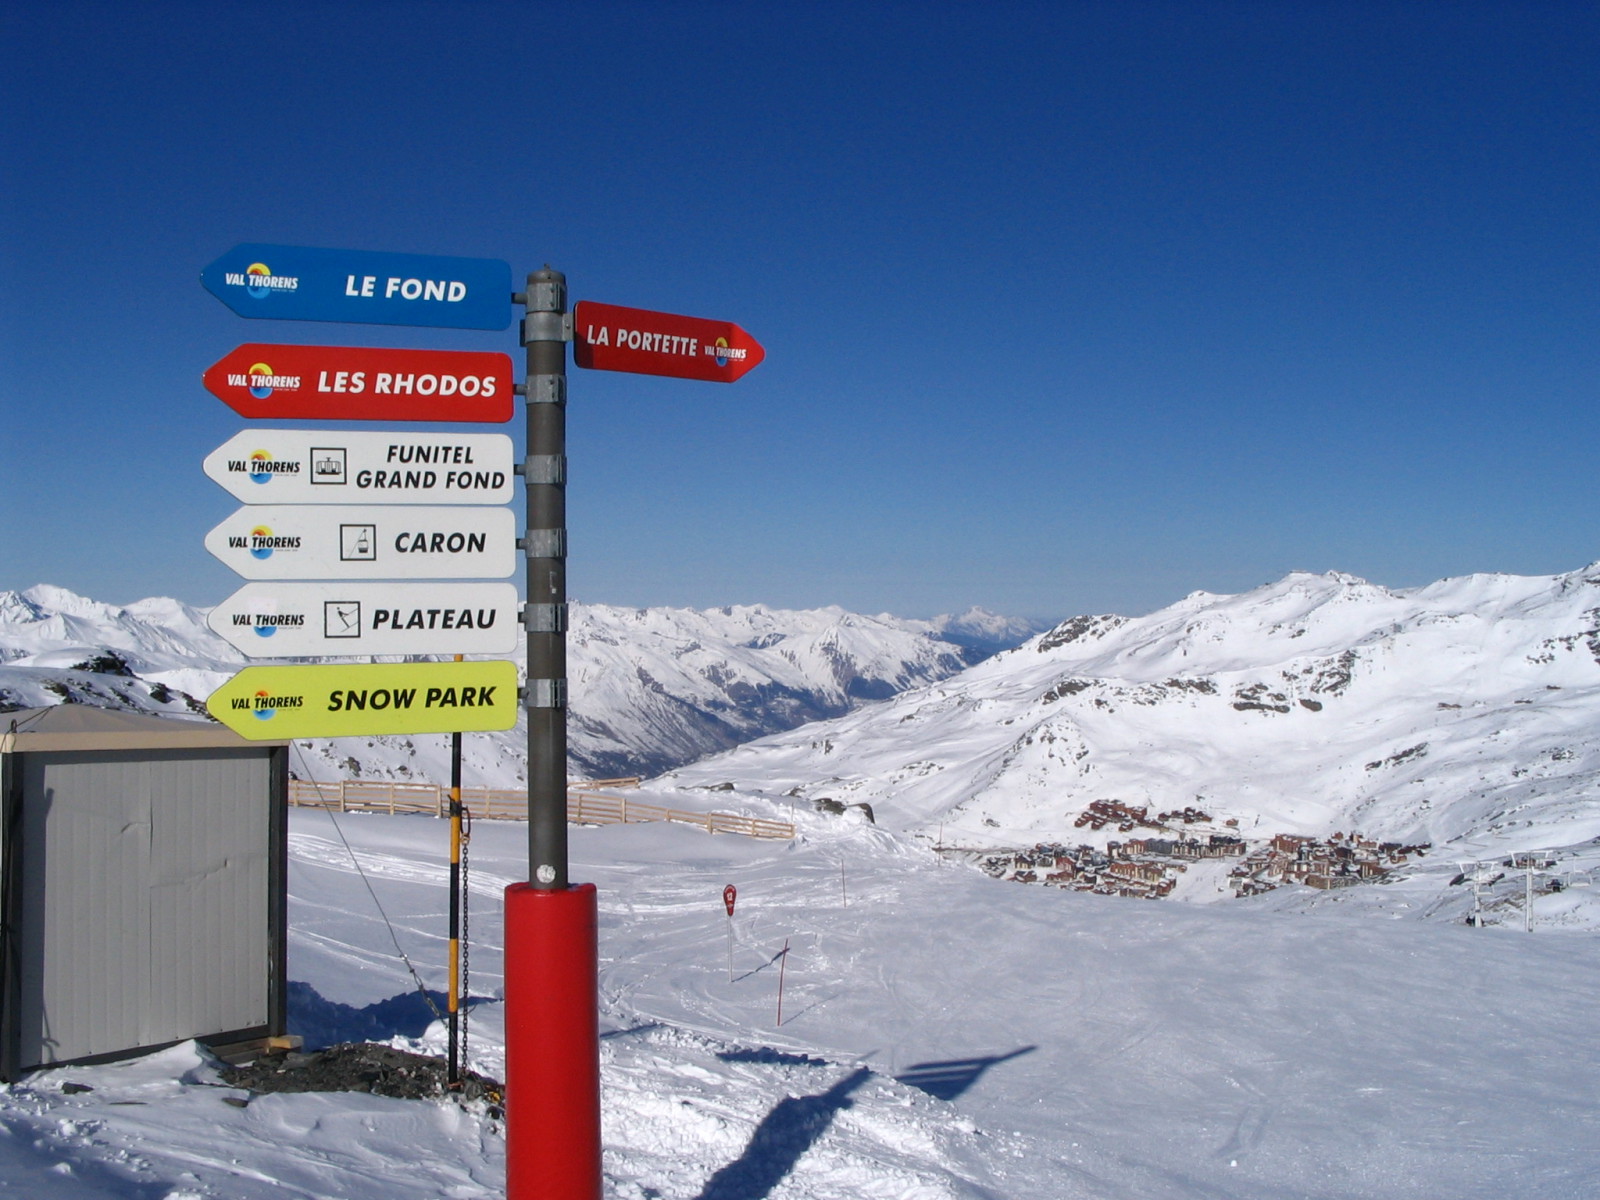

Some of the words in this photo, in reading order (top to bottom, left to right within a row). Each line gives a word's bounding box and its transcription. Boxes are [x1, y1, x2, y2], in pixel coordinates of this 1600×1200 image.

[225, 272, 245, 286] VAL
[249, 274, 298, 289] THORENS
[345, 275, 376, 298] LE
[385, 277, 467, 302] FOND
[587, 324, 609, 346] LA
[616, 328, 698, 357] PORTETTE
[704, 345, 715, 356] VAL
[716, 346, 747, 360] THORENS
[227, 373, 247, 387] VAL
[251, 374, 300, 388] THORENS
[317, 371, 365, 393] LES
[374, 373, 496, 397] RHODOS
[387, 445, 474, 464] FUNITEL
[228, 460, 247, 472] VAL
[251, 460, 300, 473] THORENS
[356, 470, 437, 489] GRAND
[445, 471, 505, 490] FOND
[228, 536, 248, 548] VAL
[252, 536, 301, 549] THORENS
[395, 532, 486, 553] CARON
[232, 614, 251, 626] VAL
[255, 613, 304, 627] THORENS
[372, 609, 497, 630] PLATEAU
[231, 698, 251, 710] VAL
[254, 695, 303, 709] THORENS
[327, 688, 417, 712] SNOW
[425, 686, 497, 708] PARK
